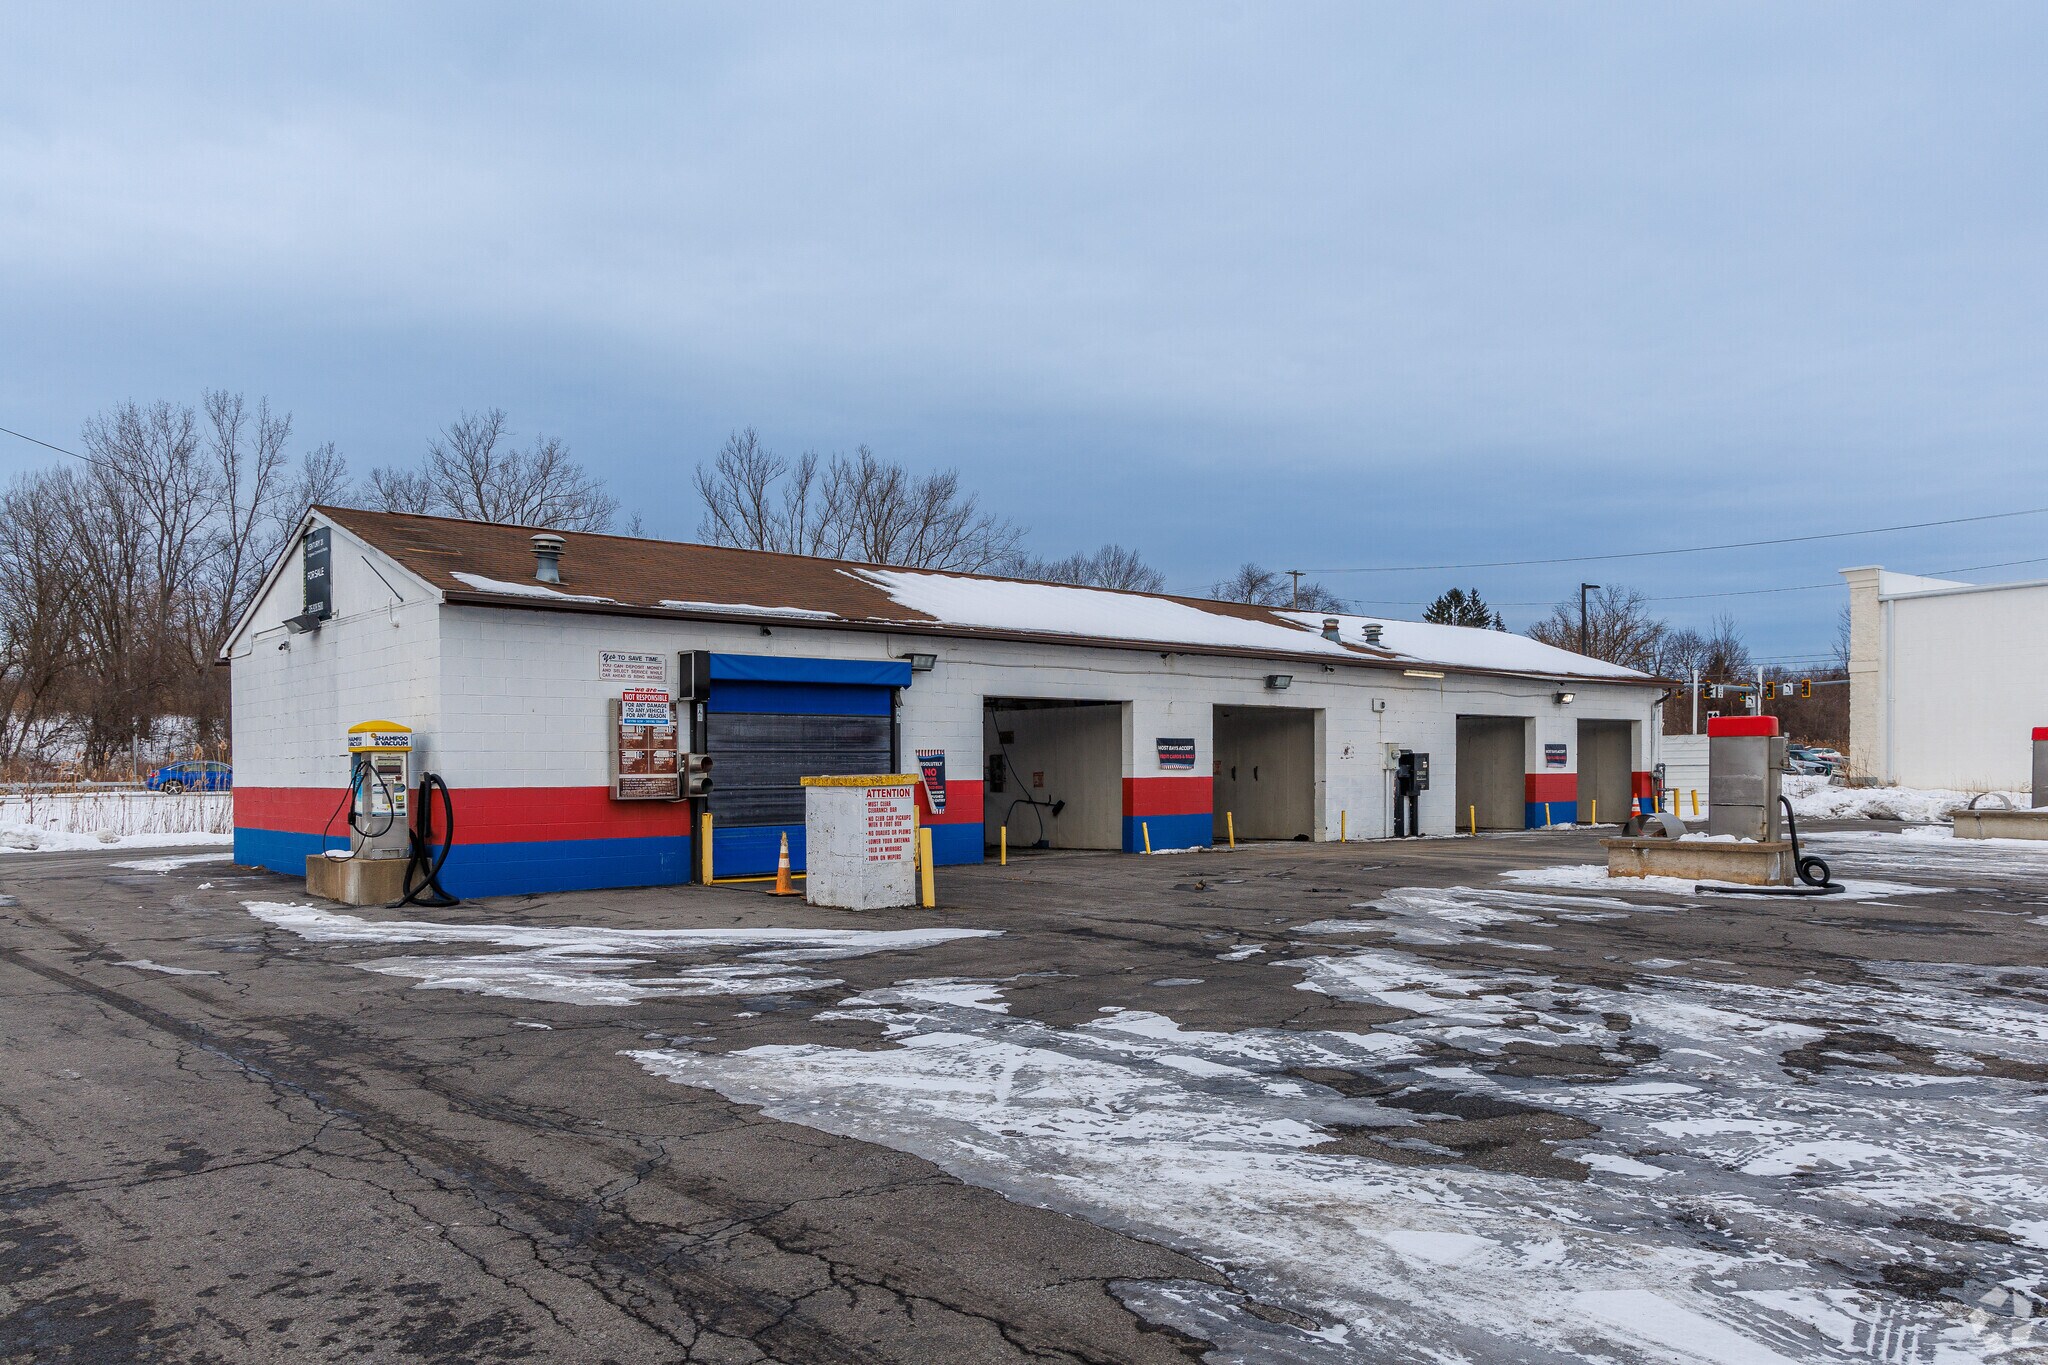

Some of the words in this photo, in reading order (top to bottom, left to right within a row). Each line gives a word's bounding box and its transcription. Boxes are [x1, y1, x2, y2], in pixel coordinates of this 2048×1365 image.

[636, 694, 668, 702] RESPONSIBLE
[925, 768, 937, 777] NO
[867, 788, 910, 798] ATTENTION
